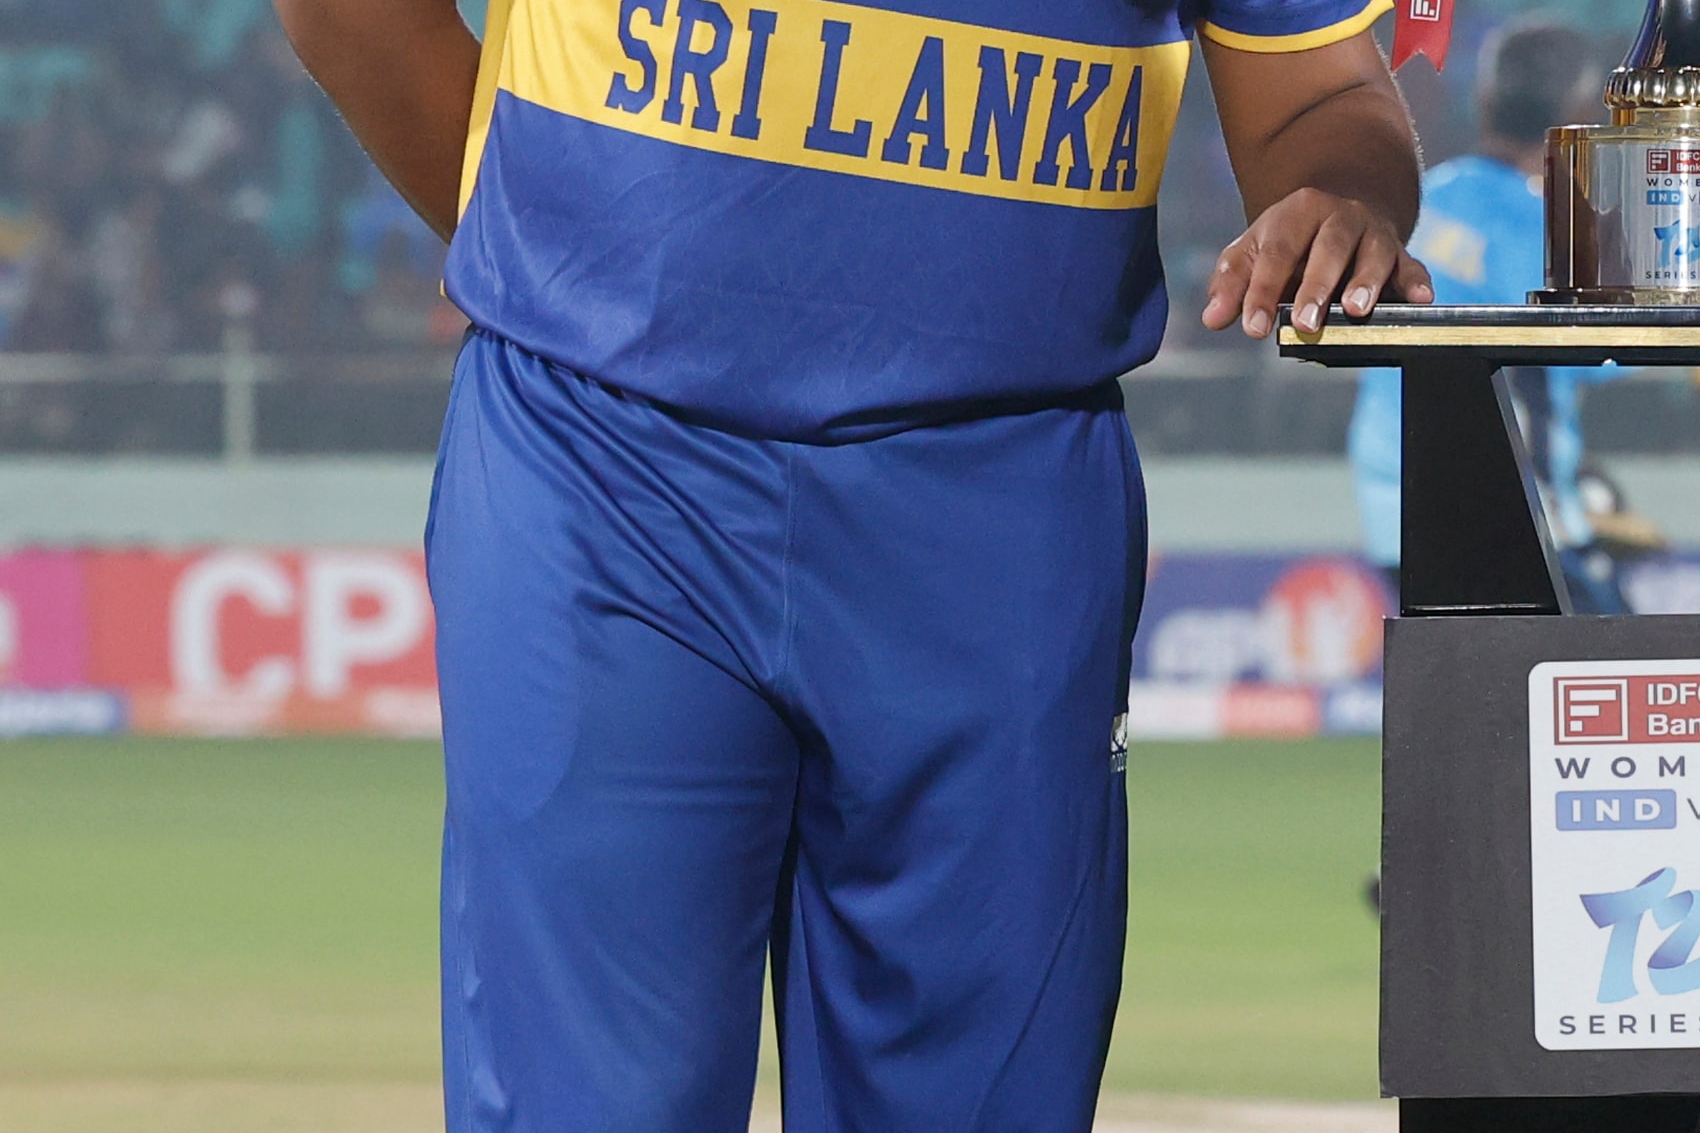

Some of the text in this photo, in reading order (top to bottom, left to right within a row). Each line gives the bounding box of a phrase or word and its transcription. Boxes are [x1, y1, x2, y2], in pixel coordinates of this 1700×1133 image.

[803, 19, 1143, 192] LANKA
[1651, 193, 1681, 203] IND
[1571, 797, 1661, 822] IND
